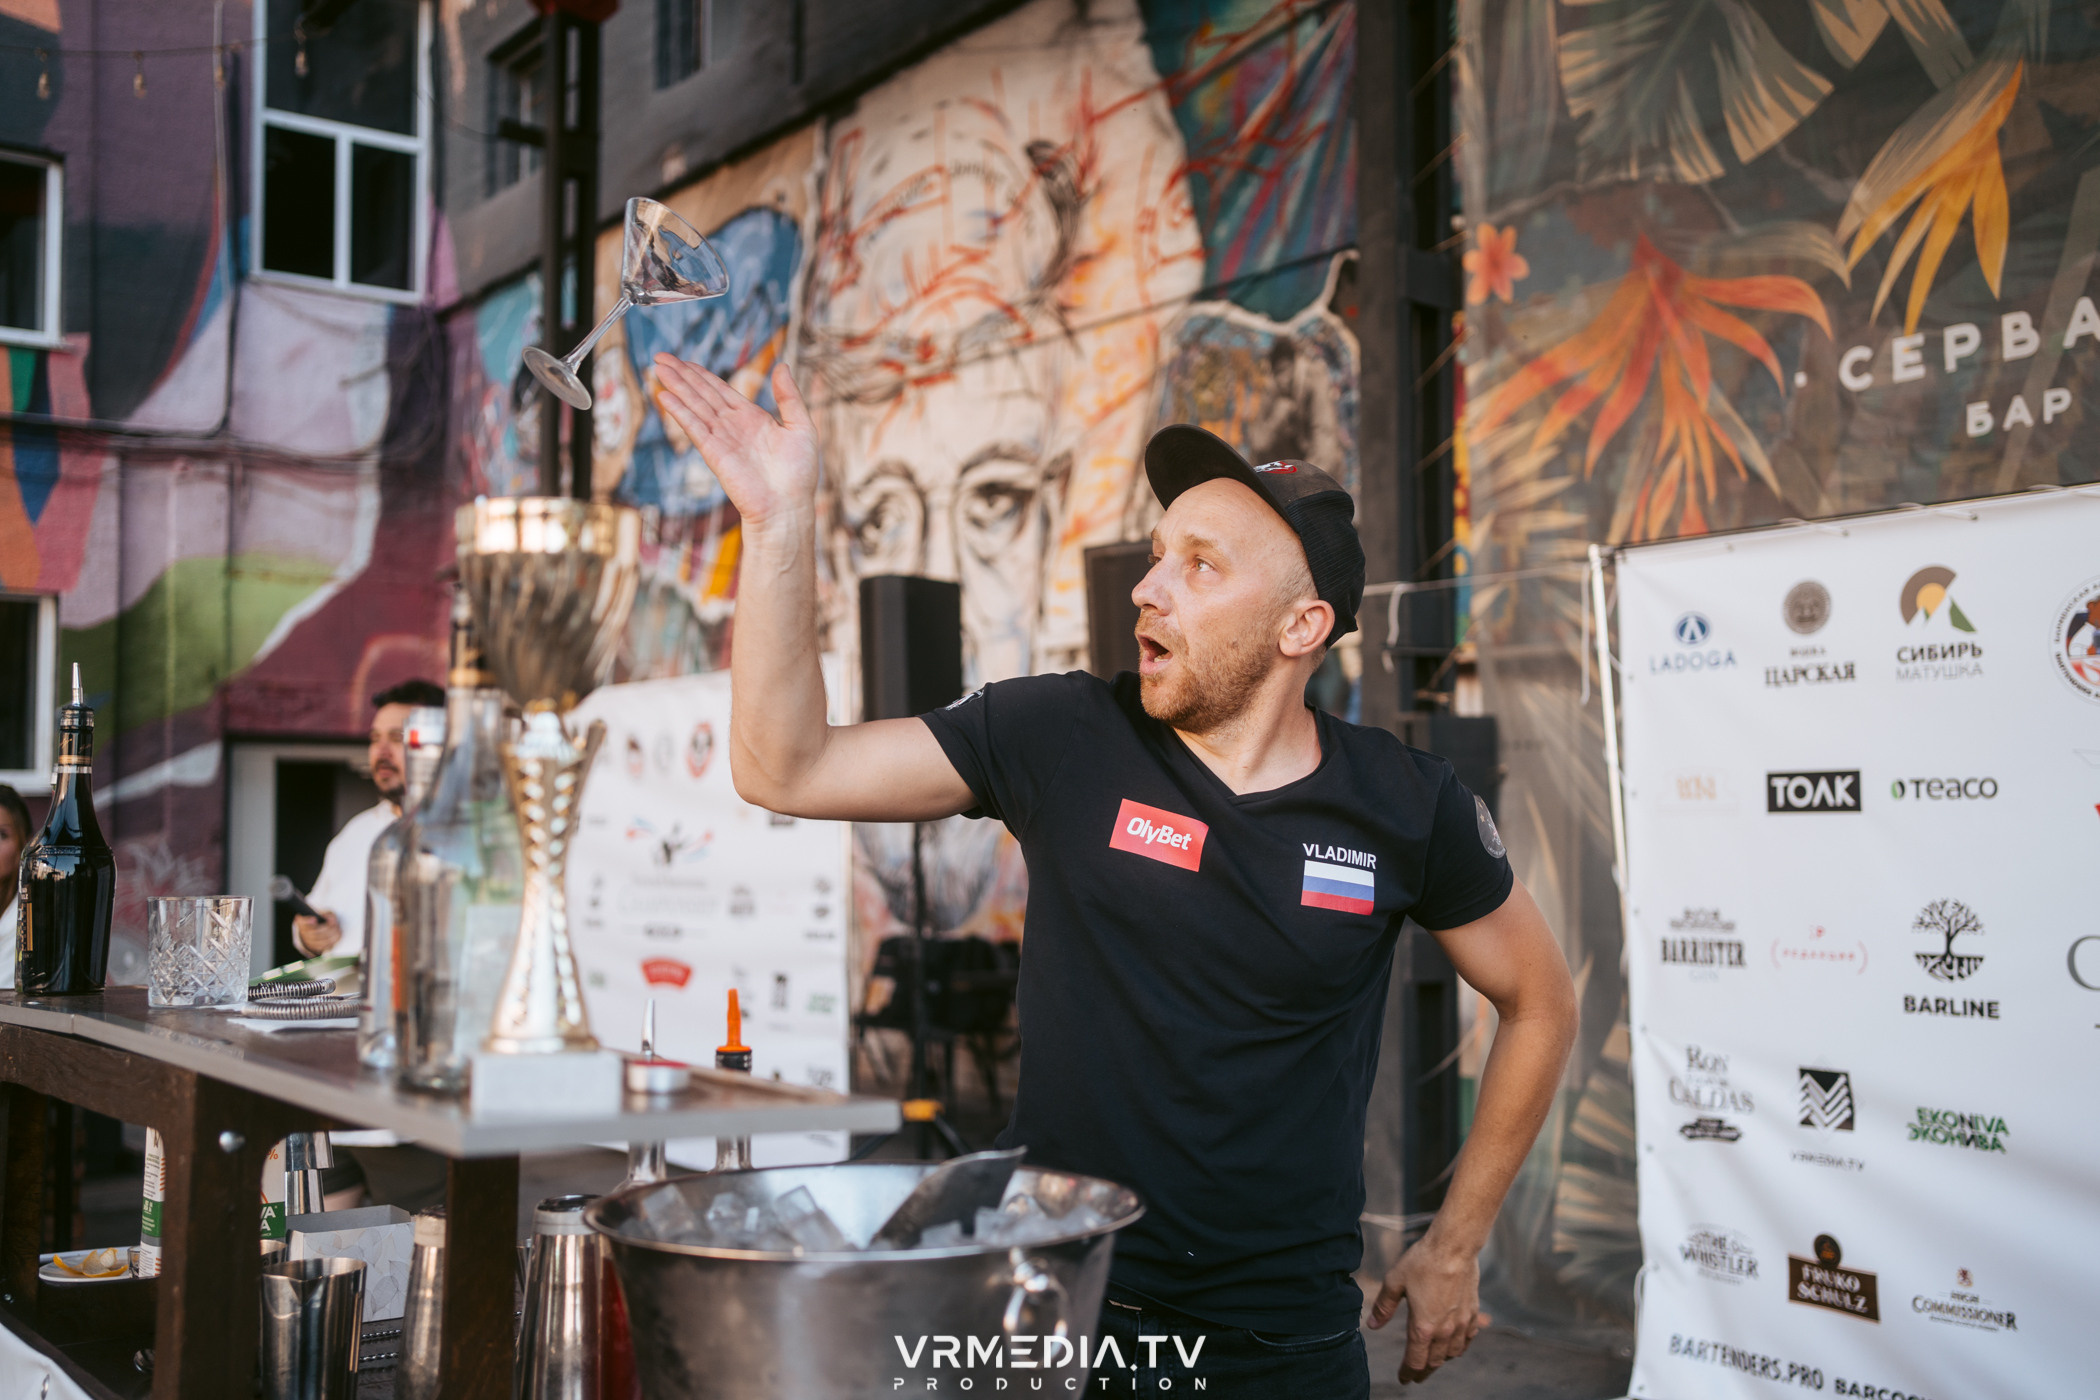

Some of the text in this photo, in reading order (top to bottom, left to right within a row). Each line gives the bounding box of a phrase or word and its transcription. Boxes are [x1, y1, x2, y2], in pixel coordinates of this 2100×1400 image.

[1966, 388, 2072, 438] БАР
[1649, 650, 1737, 675] LADOGA
[1897, 642, 1983, 664] СИБИРЬ
[1764, 662, 1856, 687] ЦАРСКАЯ
[1896, 662, 1984, 681] МАТУШКА
[1126, 816, 1193, 852] OlyBet
[1302, 842, 1378, 871] VLADIMIR
[1661, 938, 1747, 969] BARRISTER
[1904, 995, 2000, 1019] BARLINE
[1917, 1106, 2010, 1136] EKONIVA
[1801, 1264, 1861, 1294] FRUKO
[1797, 1281, 1869, 1314] SCHULZ
[1912, 1296, 2018, 1331] COMMISSIONER
